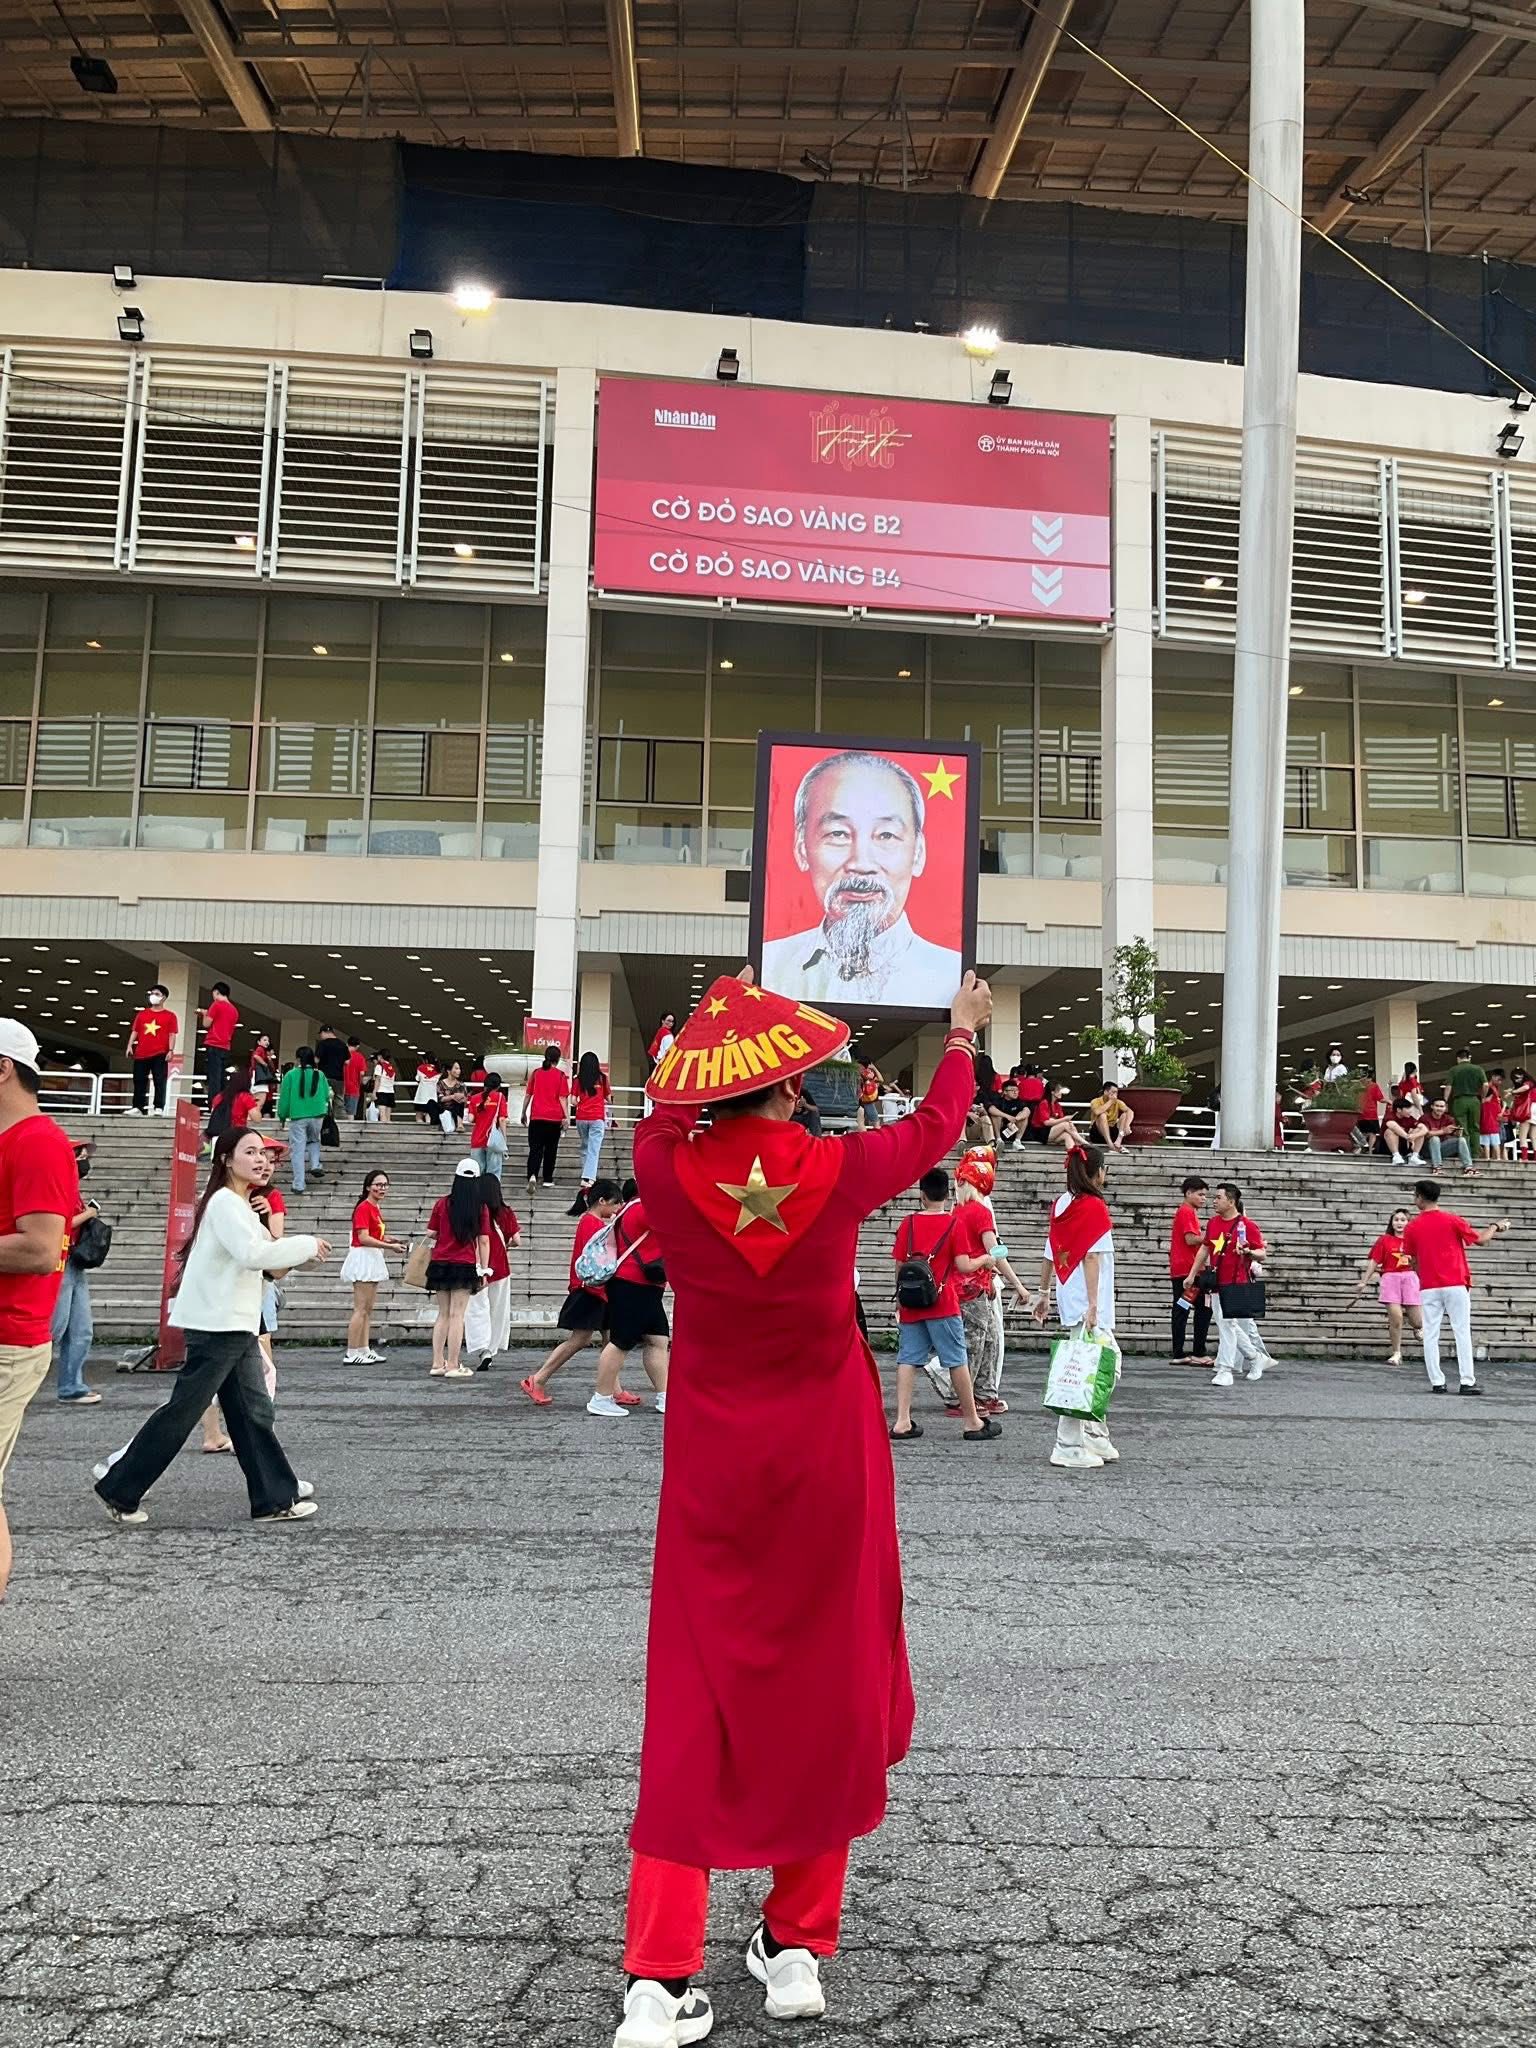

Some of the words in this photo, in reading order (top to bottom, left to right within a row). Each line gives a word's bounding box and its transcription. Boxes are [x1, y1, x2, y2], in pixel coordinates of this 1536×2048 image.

[652, 495, 691, 520] CỜ
[698, 497, 737, 523] ĐỎ
[743, 505, 793, 528] SAO
[800, 505, 867, 533] VÀNG
[874, 514, 901, 535] B2
[649, 548, 689, 573] CỜ
[695, 550, 734, 576] ĐỎ
[741, 558, 792, 580] SAO
[797, 559, 865, 585] VÀNG
[872, 567, 901, 588] B4
[675, 1024, 812, 1091] THẮNG
